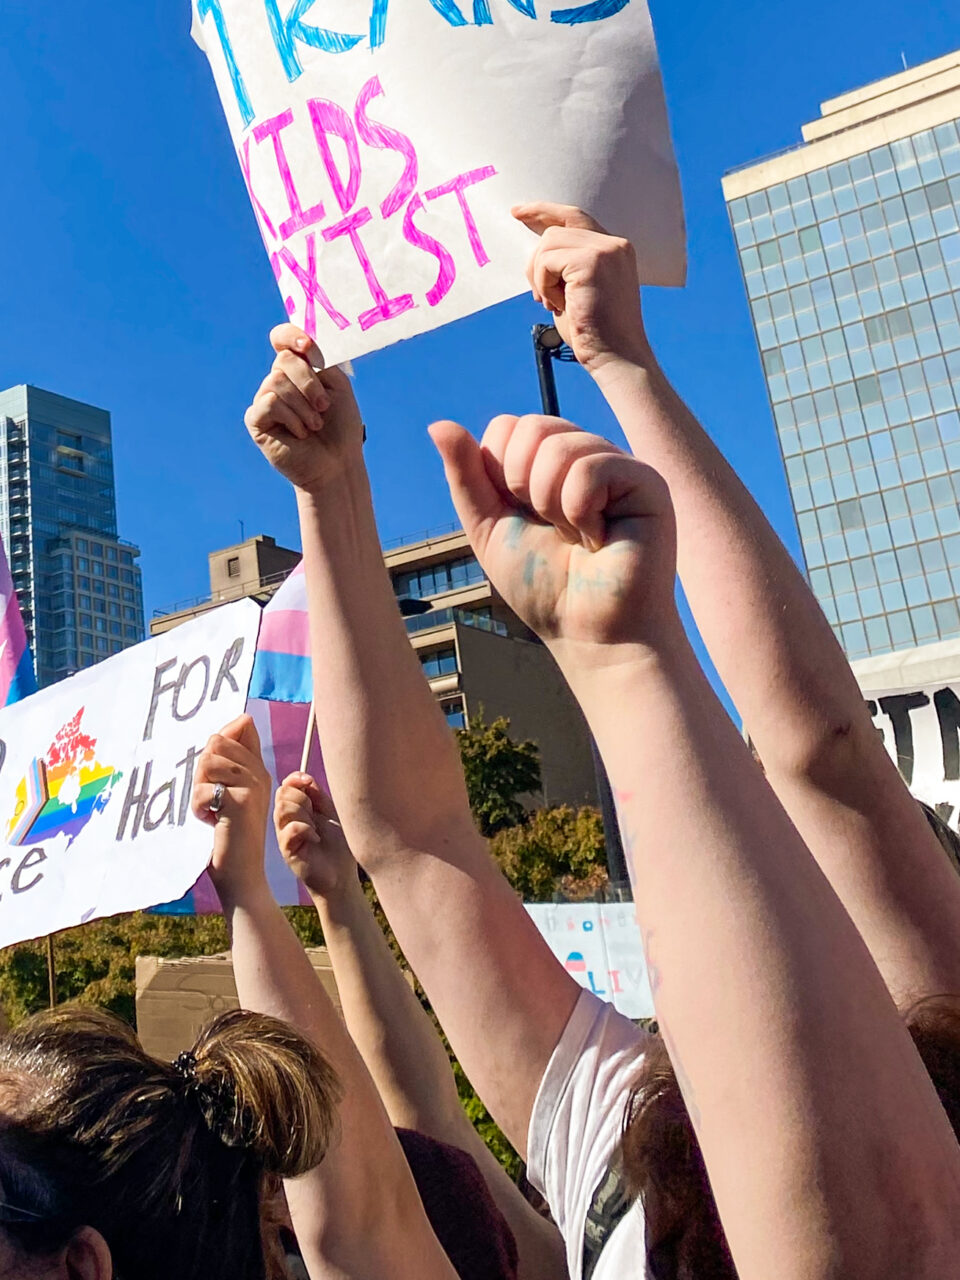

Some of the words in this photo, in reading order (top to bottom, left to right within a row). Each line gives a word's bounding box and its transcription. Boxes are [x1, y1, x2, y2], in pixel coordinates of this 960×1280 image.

[270, 164, 500, 341] XIST
[142, 636, 245, 742] FOR
[115, 745, 205, 842] Hat
[587, 970, 644, 995] LIV
